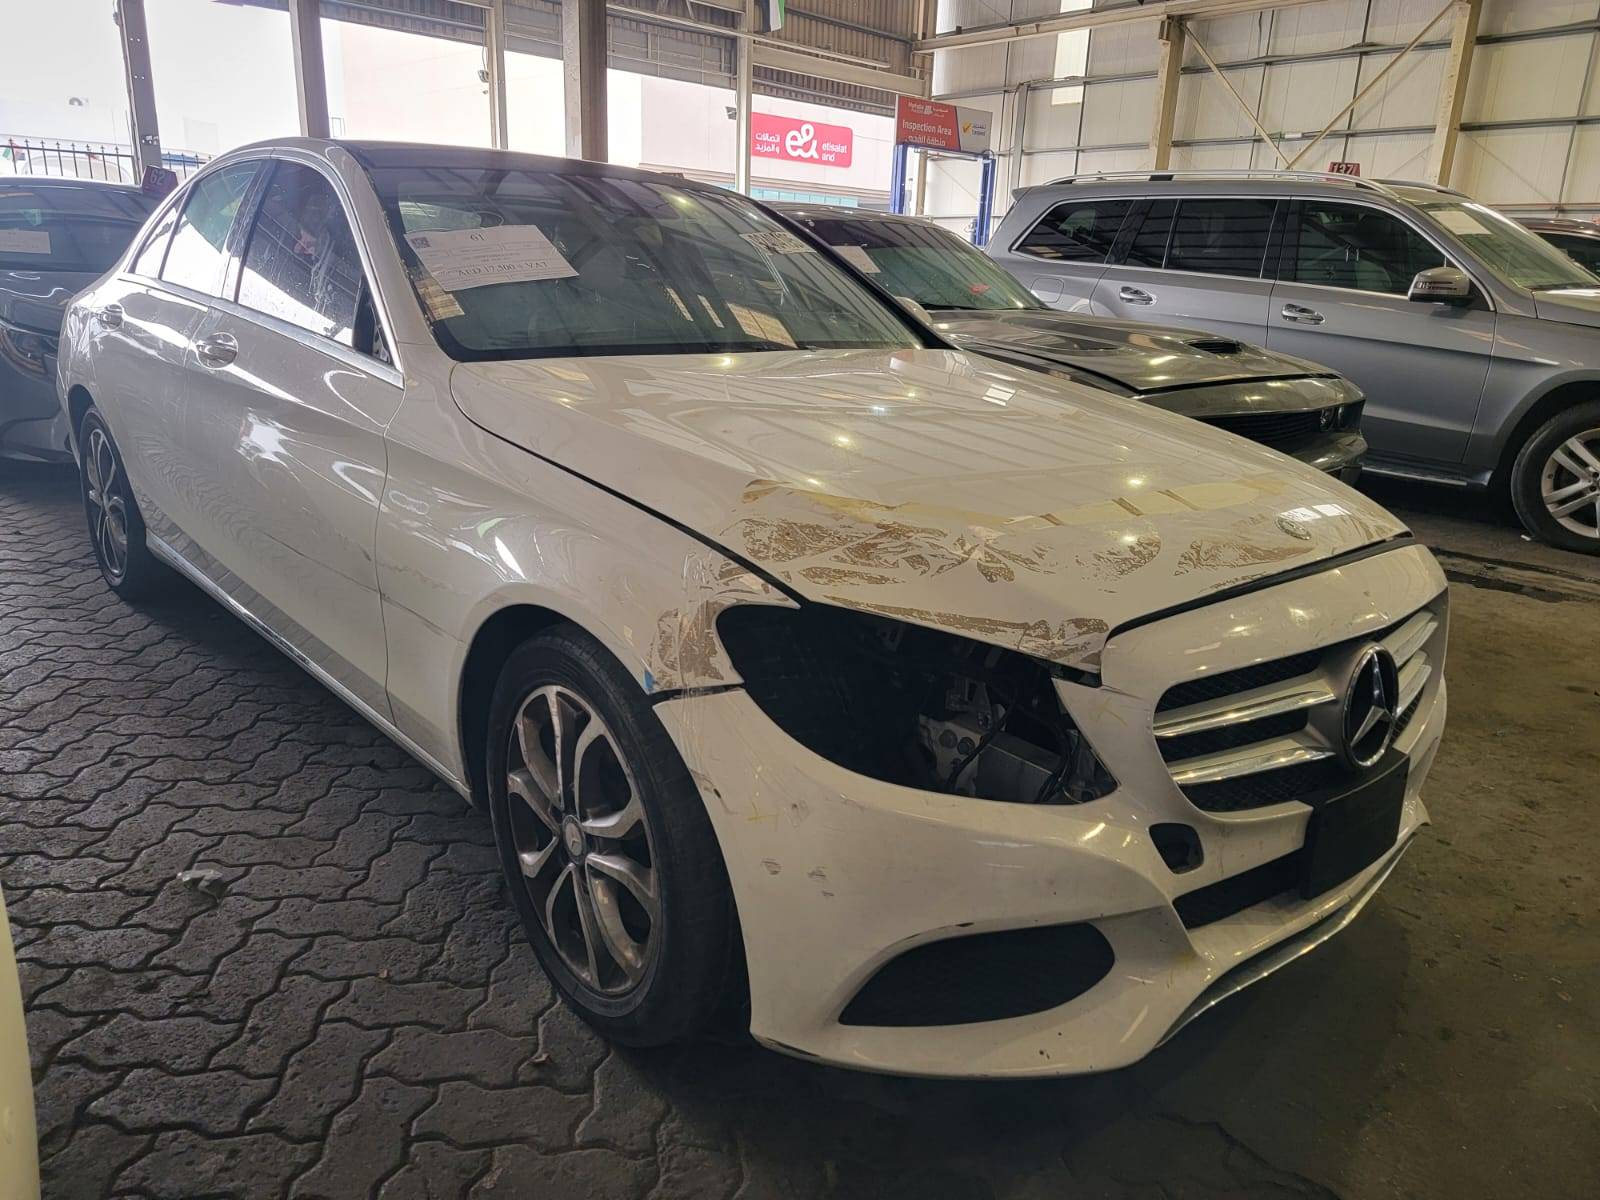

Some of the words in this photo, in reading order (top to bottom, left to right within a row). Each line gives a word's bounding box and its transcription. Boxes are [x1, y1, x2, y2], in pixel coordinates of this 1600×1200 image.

[902, 119, 936, 135] Inspection
[937, 124, 952, 137] Area
[926, 136, 946, 147] منطقة
[754, 142, 780, 155] والمزيد
[822, 142, 848, 154] etisalat
[821, 152, 836, 162] and
[150, 170, 165, 185] 62
[470, 233, 487, 242] 61
[527, 260, 549, 270] VAT
